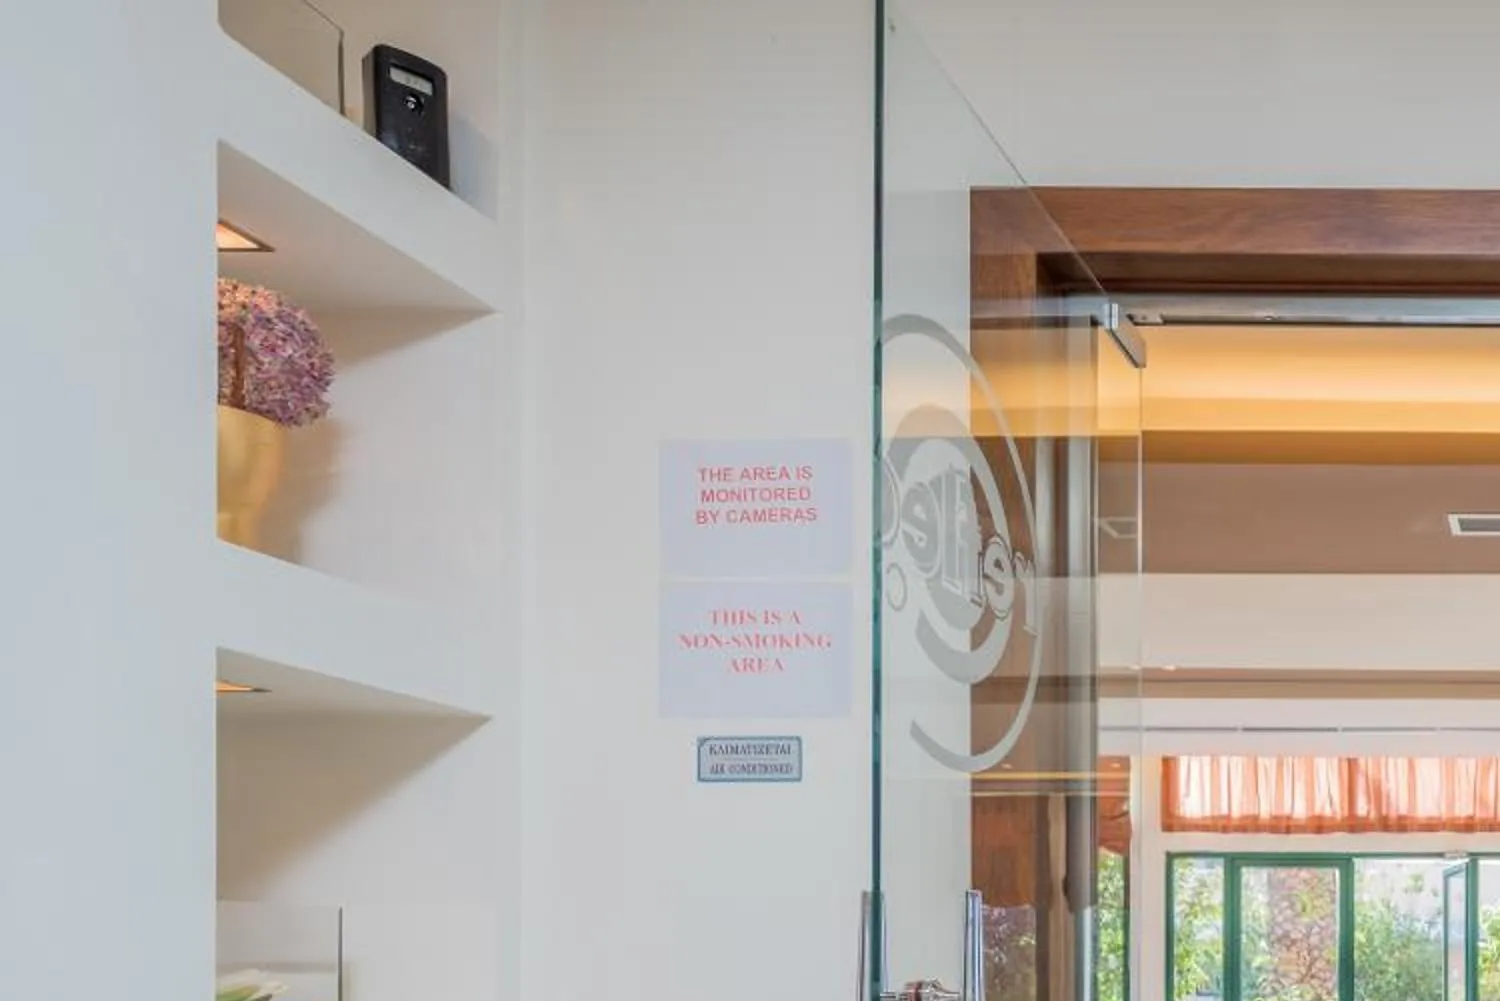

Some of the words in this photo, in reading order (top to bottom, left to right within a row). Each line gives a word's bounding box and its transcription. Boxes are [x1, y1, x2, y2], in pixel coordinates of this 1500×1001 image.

[698, 467, 733, 482] THE
[739, 466, 791, 481] AREA
[795, 465, 814, 480] IS
[701, 487, 811, 503] MONITORED
[696, 509, 720, 524] BY
[726, 507, 818, 523] CAMERAS
[708, 610, 758, 626] THIS
[763, 610, 784, 625] IS
[790, 609, 802, 625] A
[679, 634, 832, 650] NON-SMOKING
[727, 657, 785, 673] AREA
[709, 763, 724, 775] AIR
[728, 763, 793, 775] CONDITIONED
